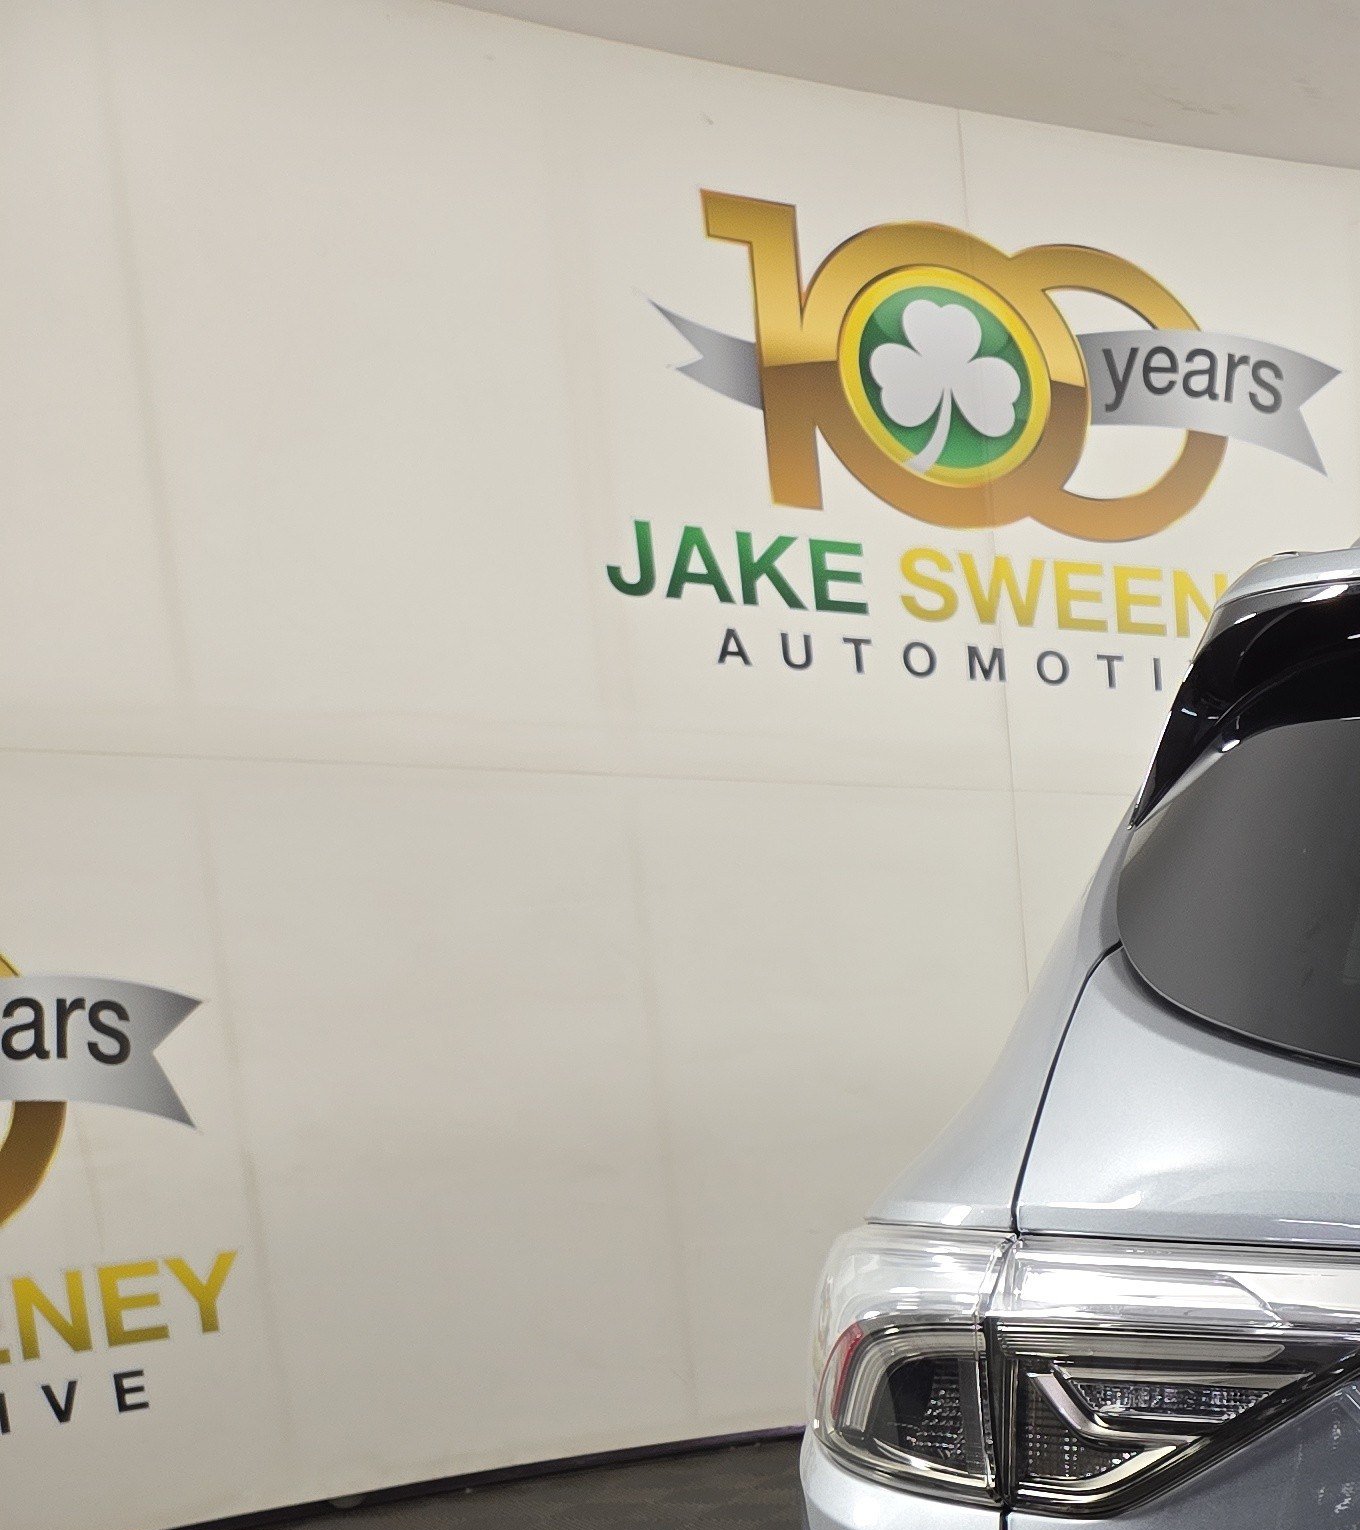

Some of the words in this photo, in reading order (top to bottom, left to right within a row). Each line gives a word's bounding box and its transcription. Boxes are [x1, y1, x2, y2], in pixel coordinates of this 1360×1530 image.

[701, 189, 1229, 543] 100
[1102, 344, 1286, 414] years
[606, 520, 869, 615] JAKE
[716, 628, 1163, 692] AUTOMOTI
[0, 1250, 238, 1365] NEY
